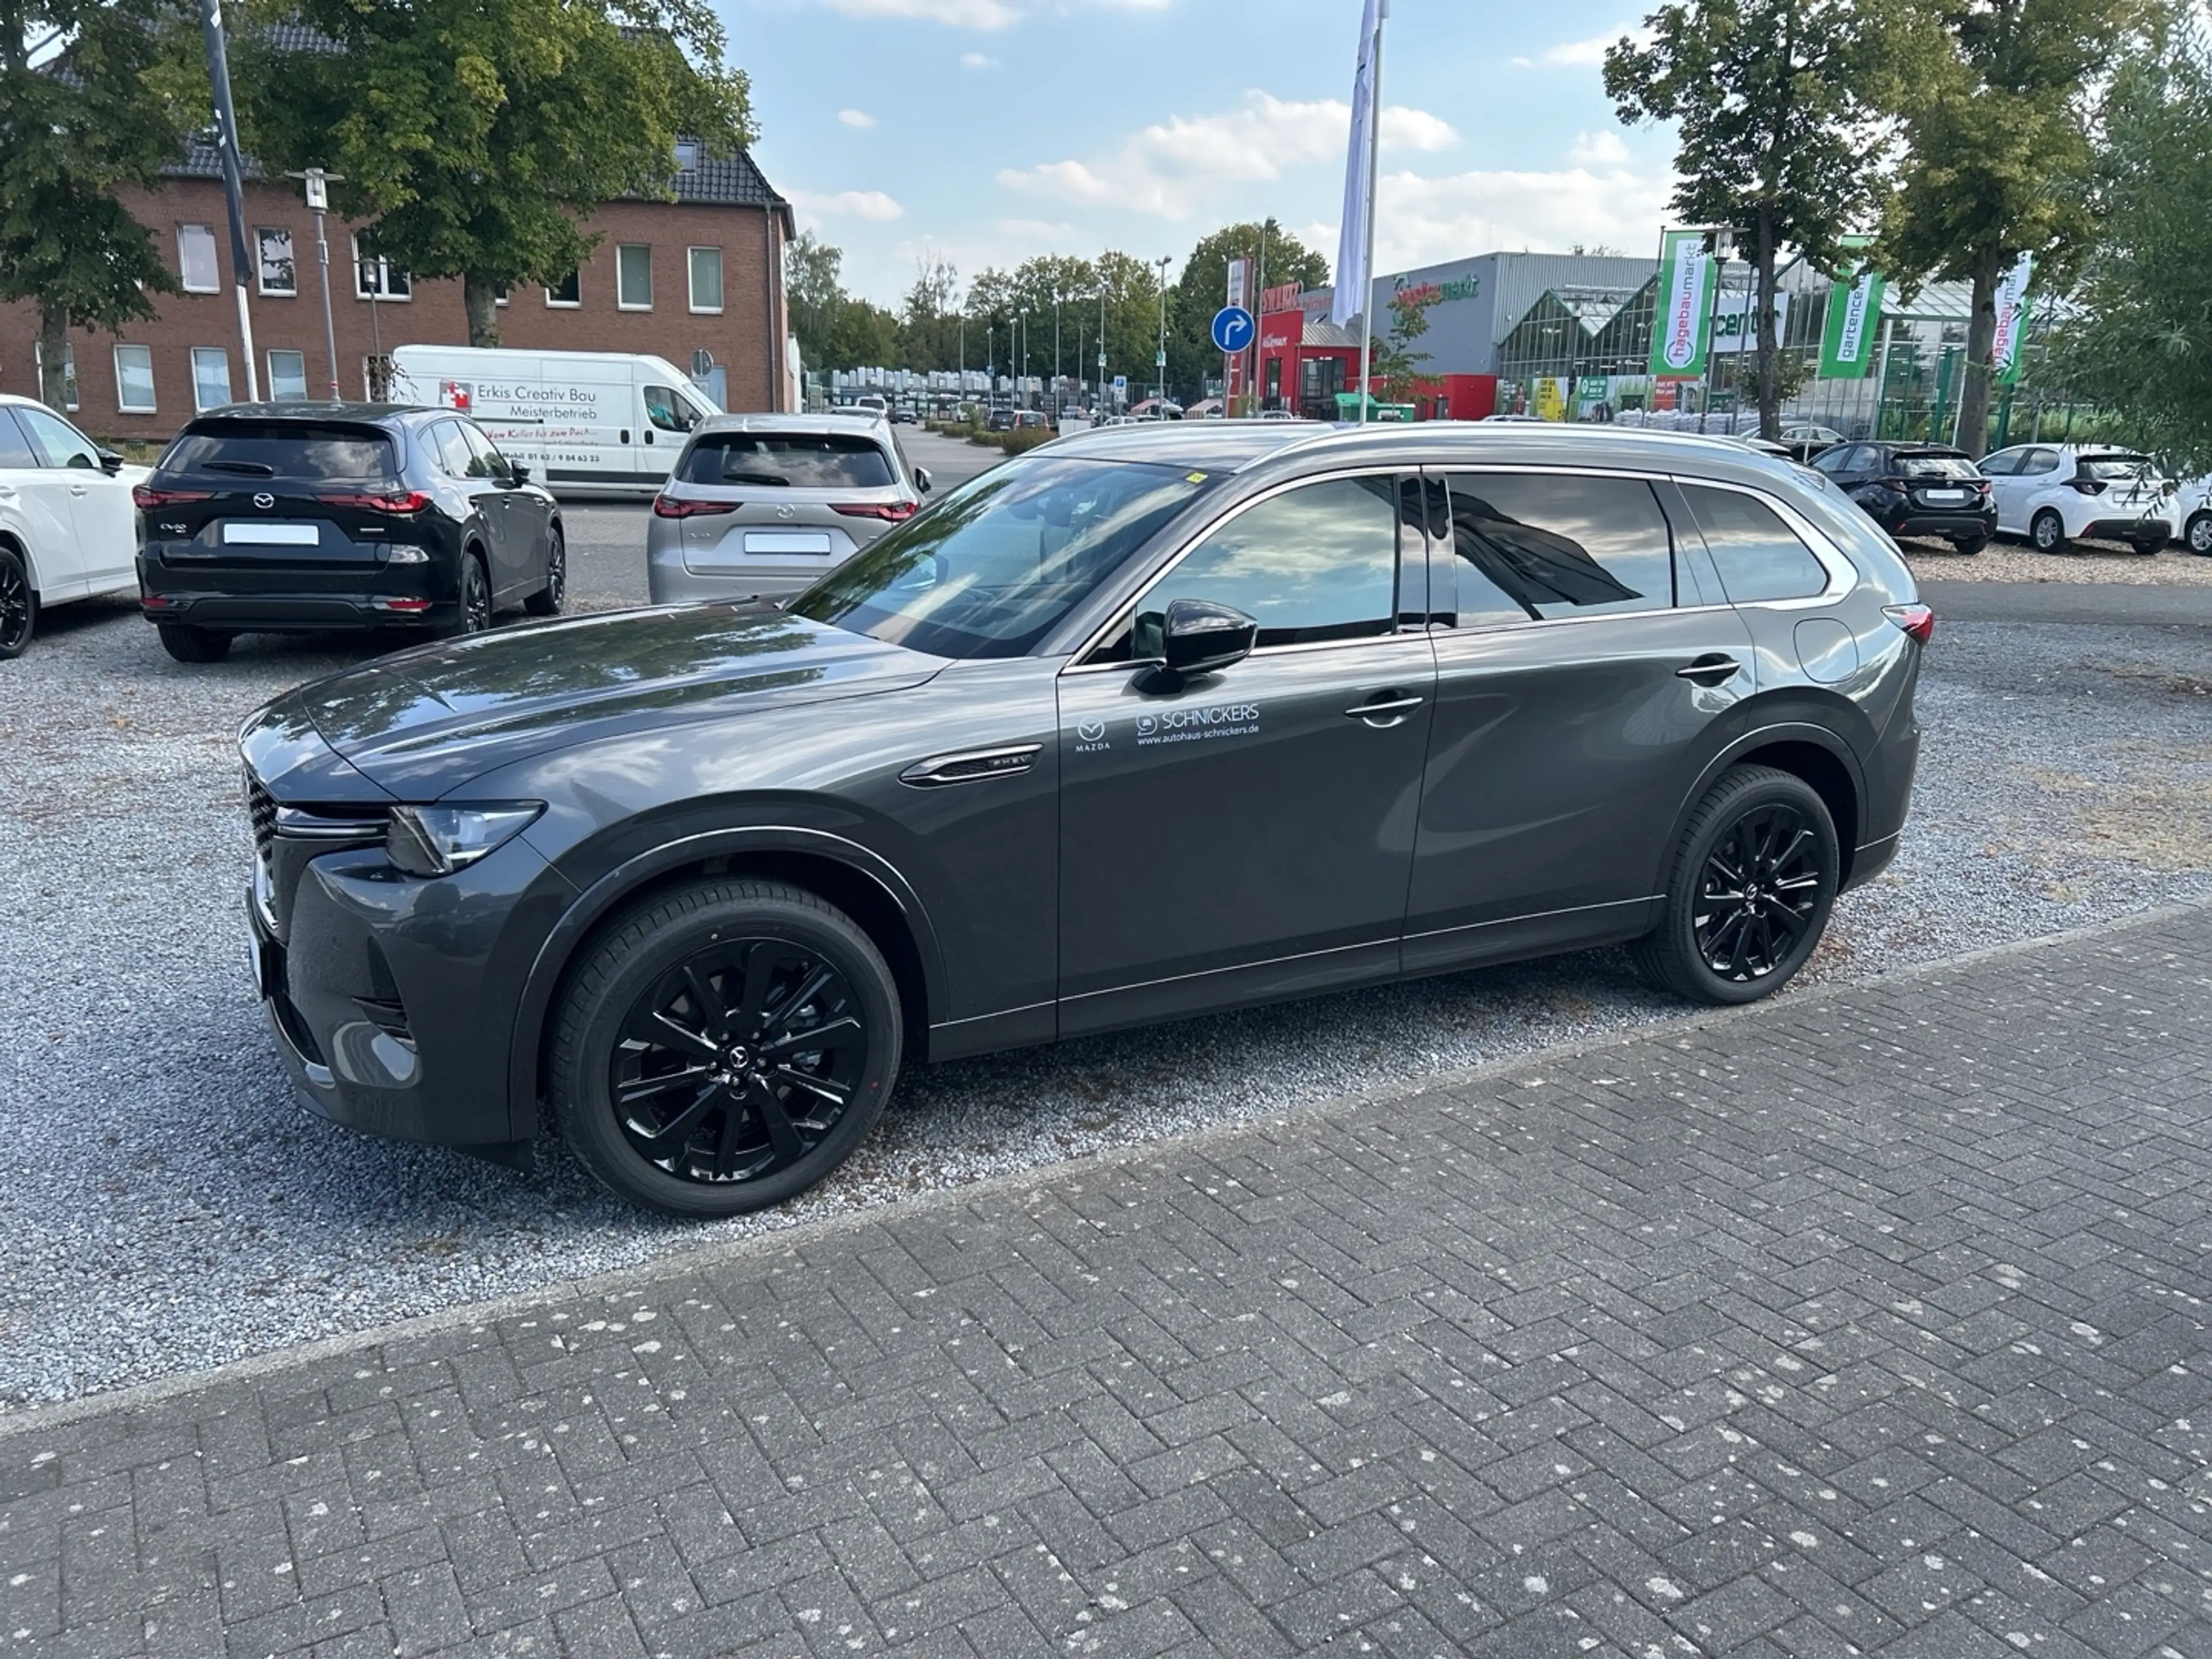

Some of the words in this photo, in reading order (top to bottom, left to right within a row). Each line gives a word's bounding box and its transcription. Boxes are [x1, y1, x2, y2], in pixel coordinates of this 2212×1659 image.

[1673, 243, 1697, 357] hagebaumarkt
[478, 385, 511, 399] Erkis
[515, 385, 565, 400] Creativ
[570, 388, 596, 402] Bau
[510, 405, 597, 419] Meisterbetrieb
[1162, 703, 1259, 729] SCHNICKERS
[1137, 724, 1259, 746] www.autohaus-schnickers.de
[1075, 742, 1111, 752] MAZDA
